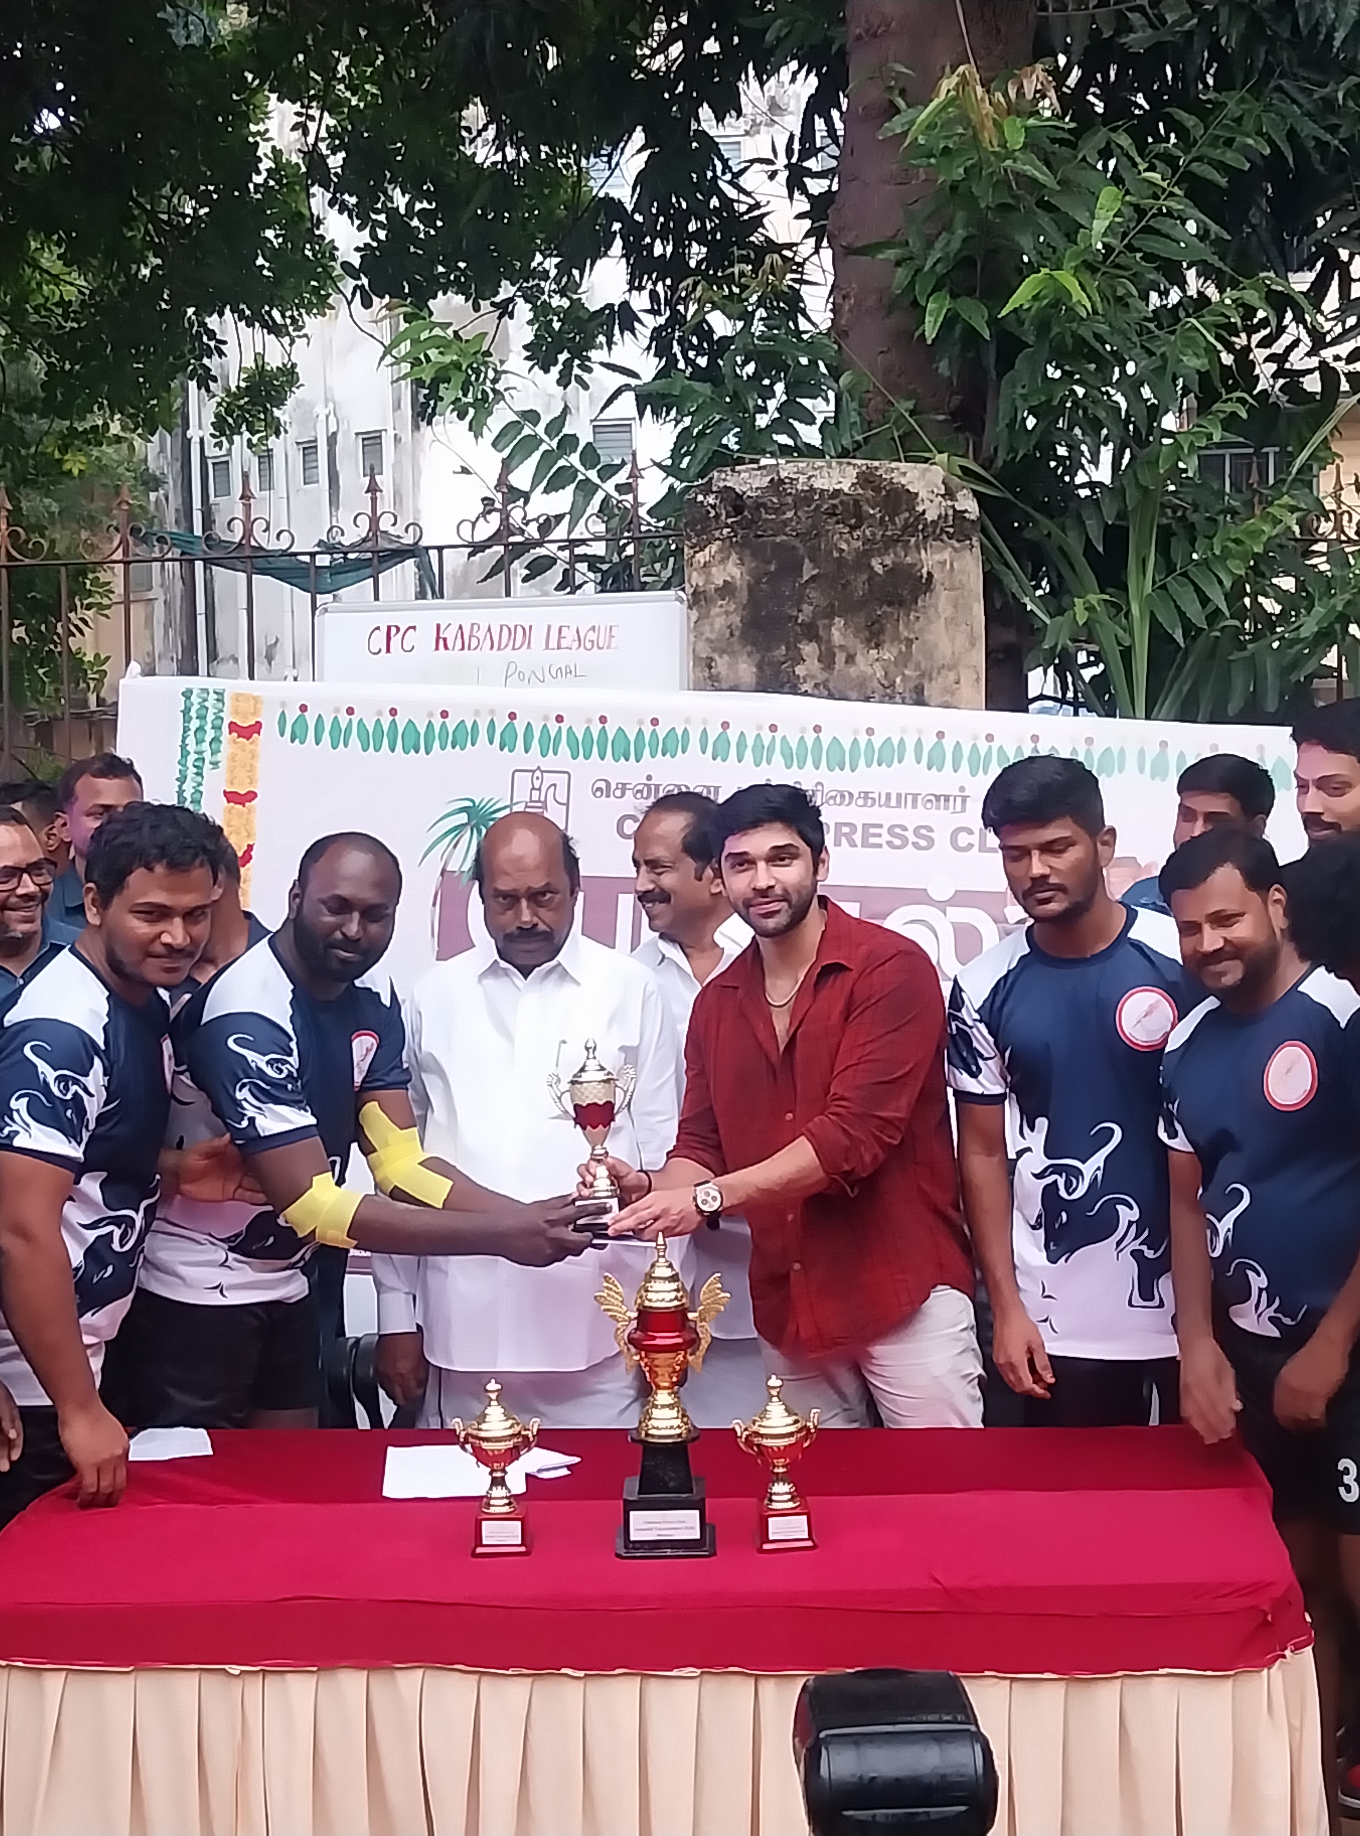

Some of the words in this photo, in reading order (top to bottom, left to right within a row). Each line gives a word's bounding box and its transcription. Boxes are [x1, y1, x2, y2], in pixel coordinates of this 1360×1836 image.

[367, 624, 417, 656] CPC
[433, 622, 534, 652] KABADDI
[542, 623, 620, 651] LEAGUE
[504, 660, 588, 688] PONGAL
[824, 821, 936, 852] RESS
